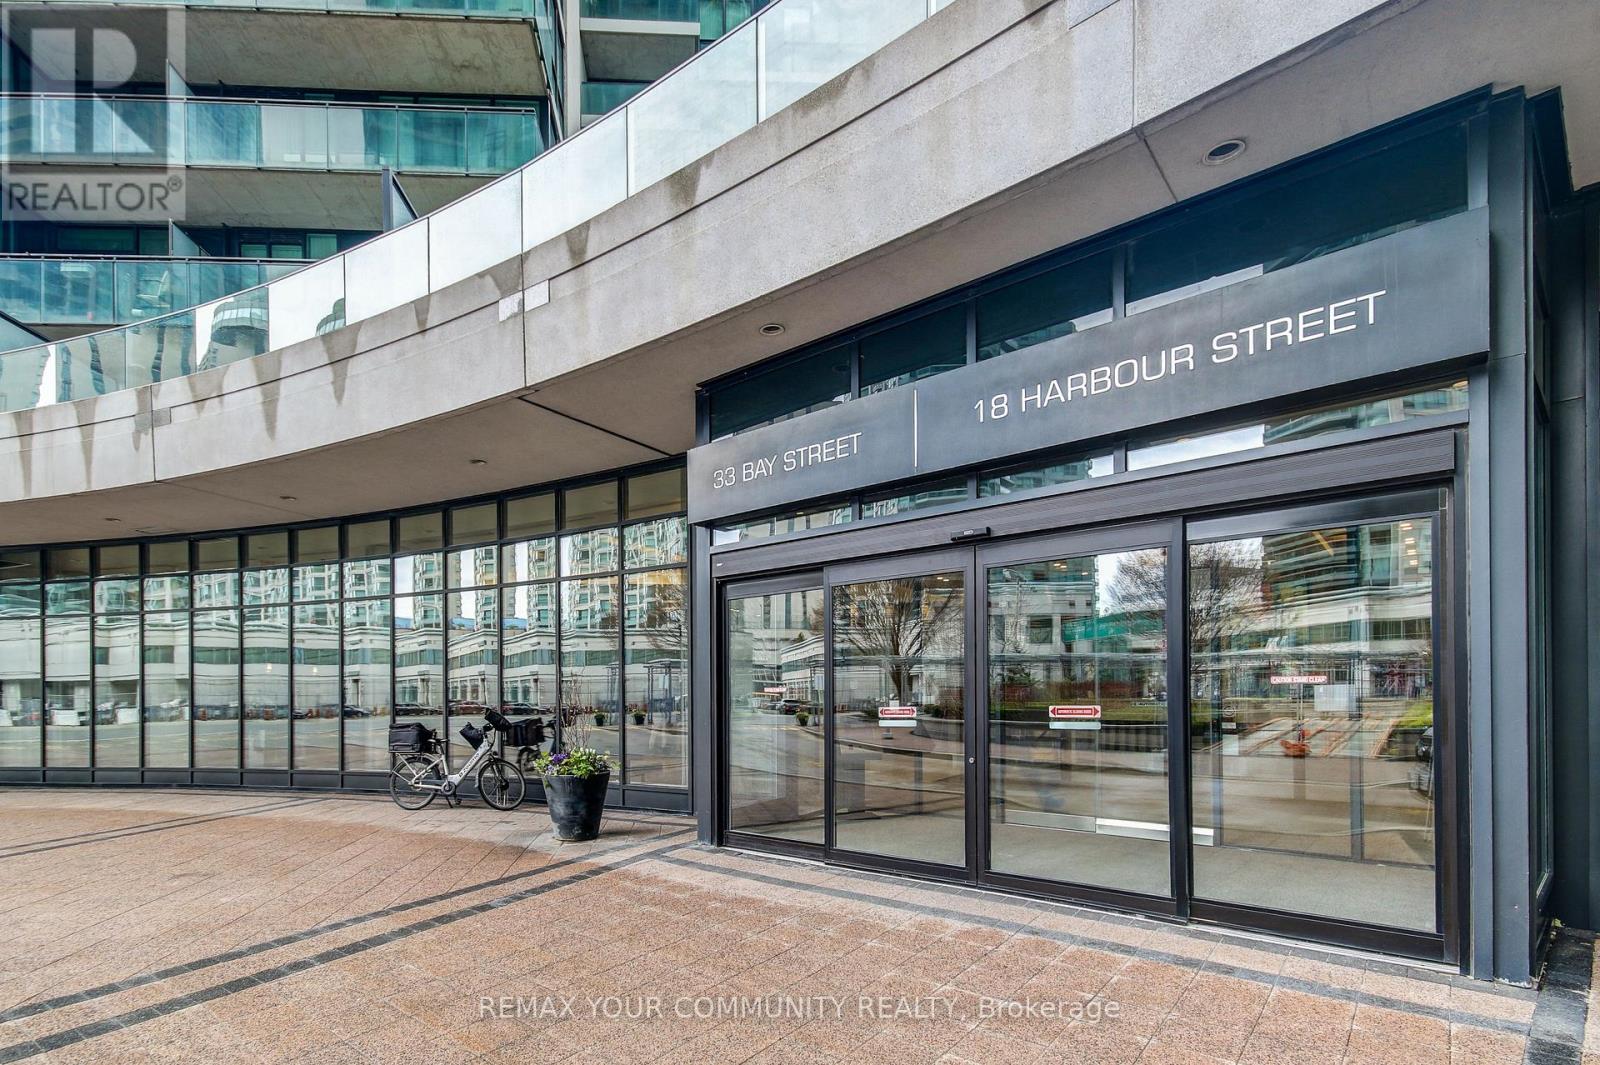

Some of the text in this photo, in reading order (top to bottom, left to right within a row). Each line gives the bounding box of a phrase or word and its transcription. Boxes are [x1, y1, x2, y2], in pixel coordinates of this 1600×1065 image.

[974, 290, 1387, 423] 18 HARBOUR STREET
[713, 432, 863, 489] 33 BAY STREET
